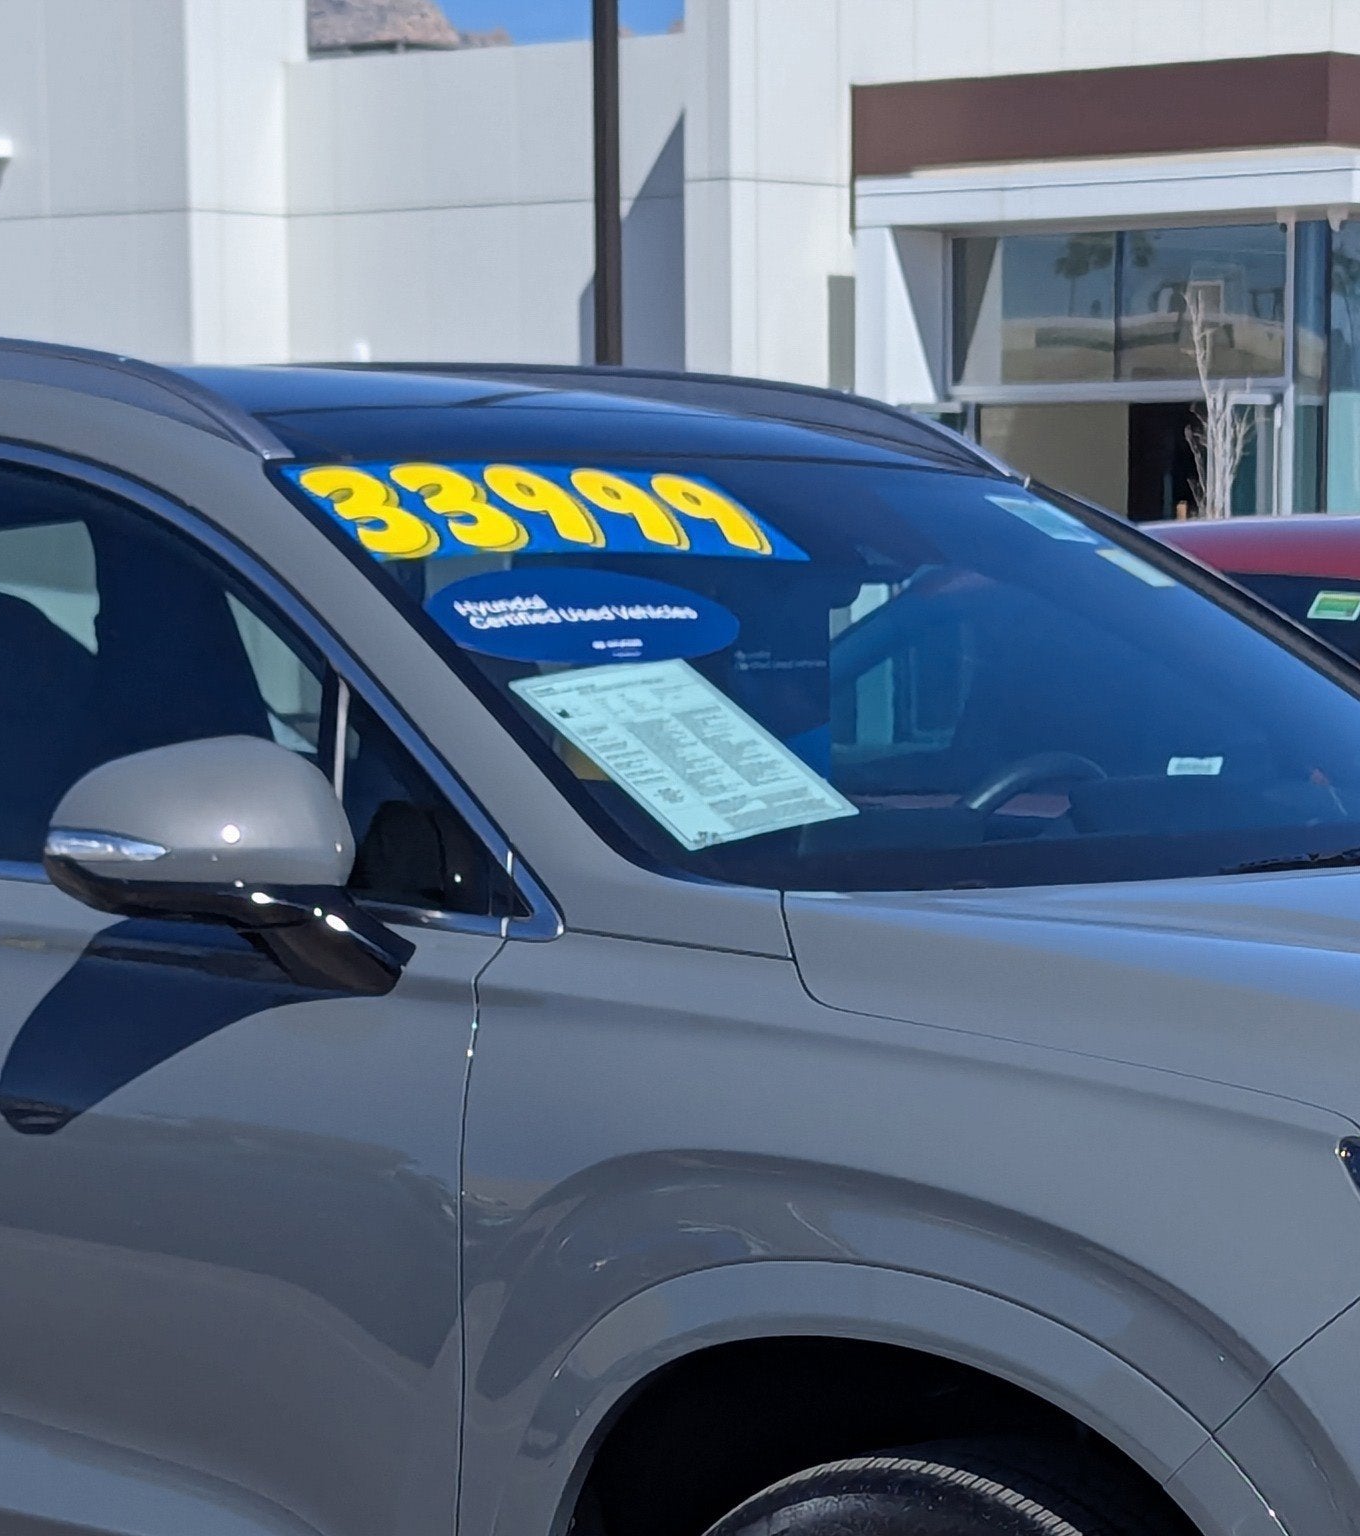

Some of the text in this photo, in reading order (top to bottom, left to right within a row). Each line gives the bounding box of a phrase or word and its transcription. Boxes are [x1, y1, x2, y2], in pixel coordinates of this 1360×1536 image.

[299, 462, 773, 560] 33999
[453, 594, 547, 616] Hyundai
[469, 604, 698, 629] Certified Used Vehicles
